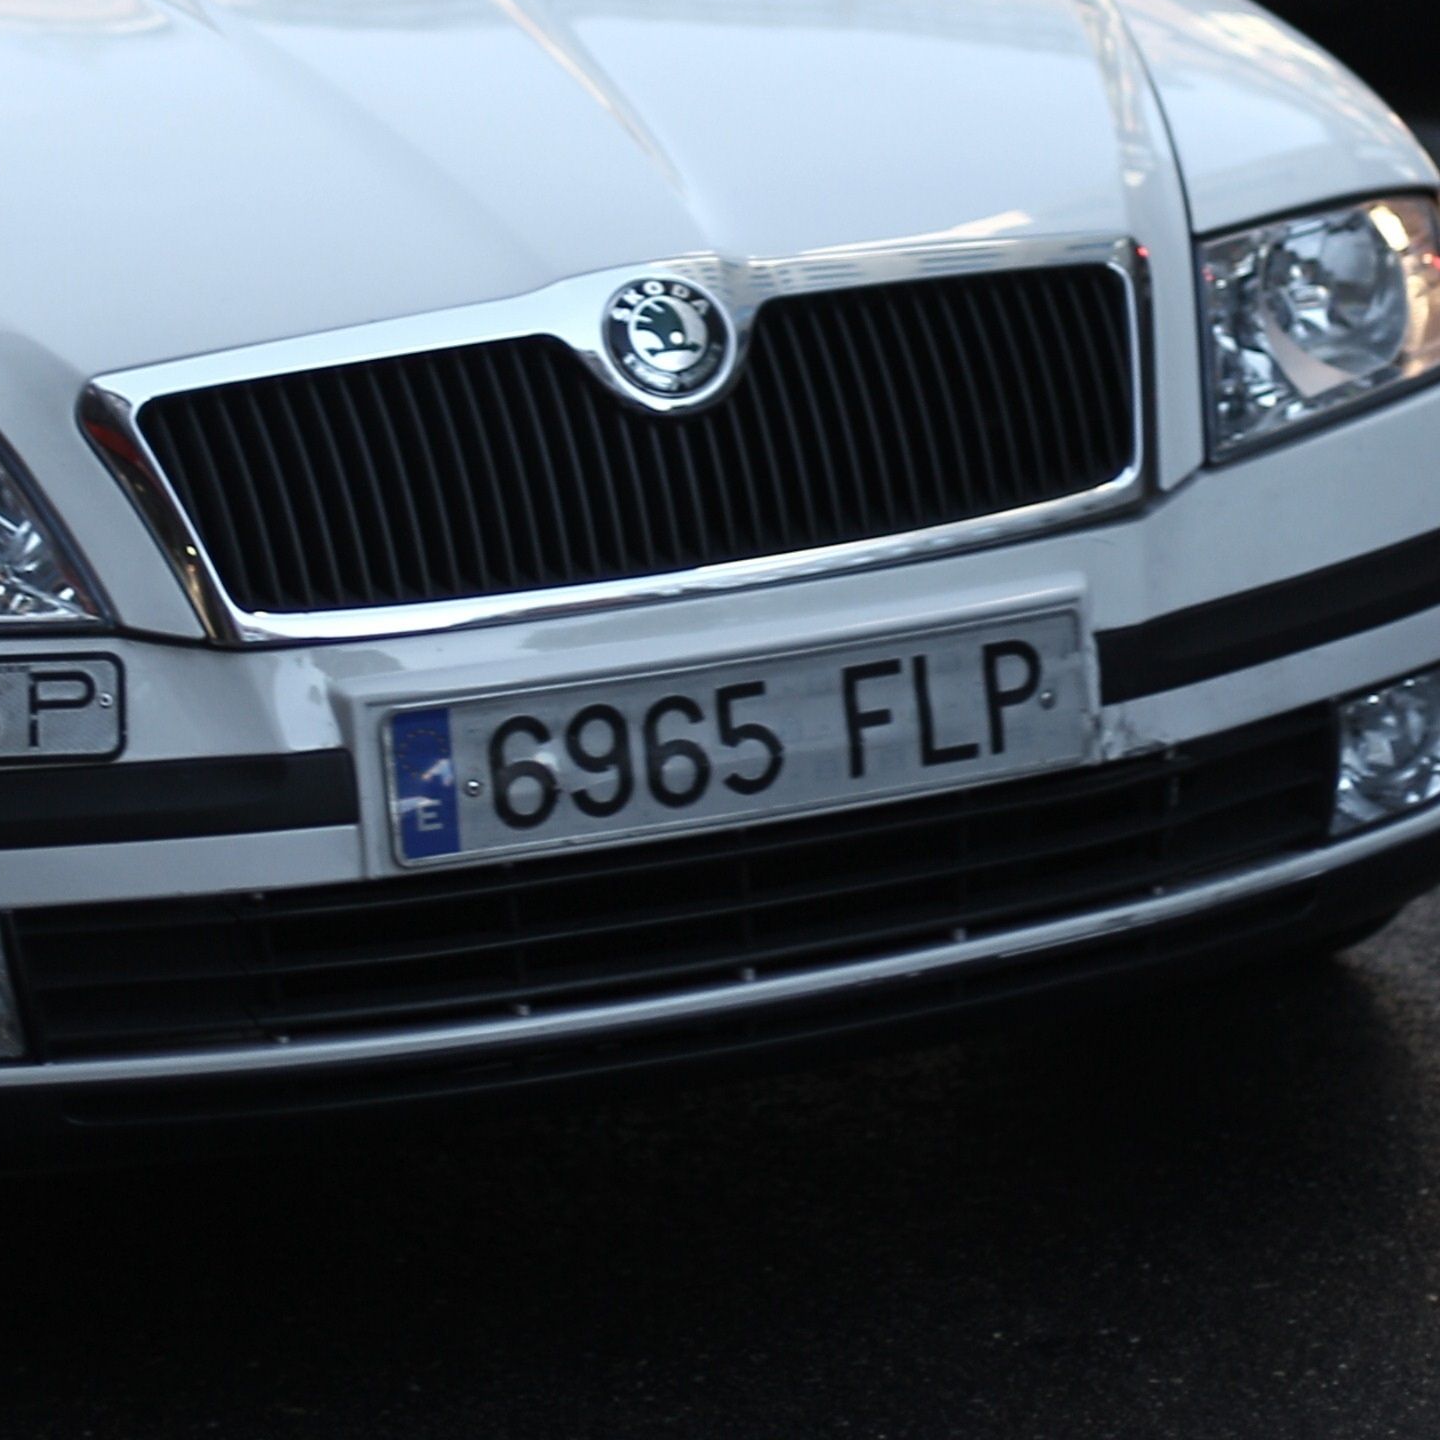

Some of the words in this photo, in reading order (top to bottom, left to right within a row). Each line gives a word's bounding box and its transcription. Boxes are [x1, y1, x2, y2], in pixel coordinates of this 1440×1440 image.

[489, 678, 785, 831] 6965
[840, 636, 1043, 780] FLP
[416, 798, 445, 832] E
